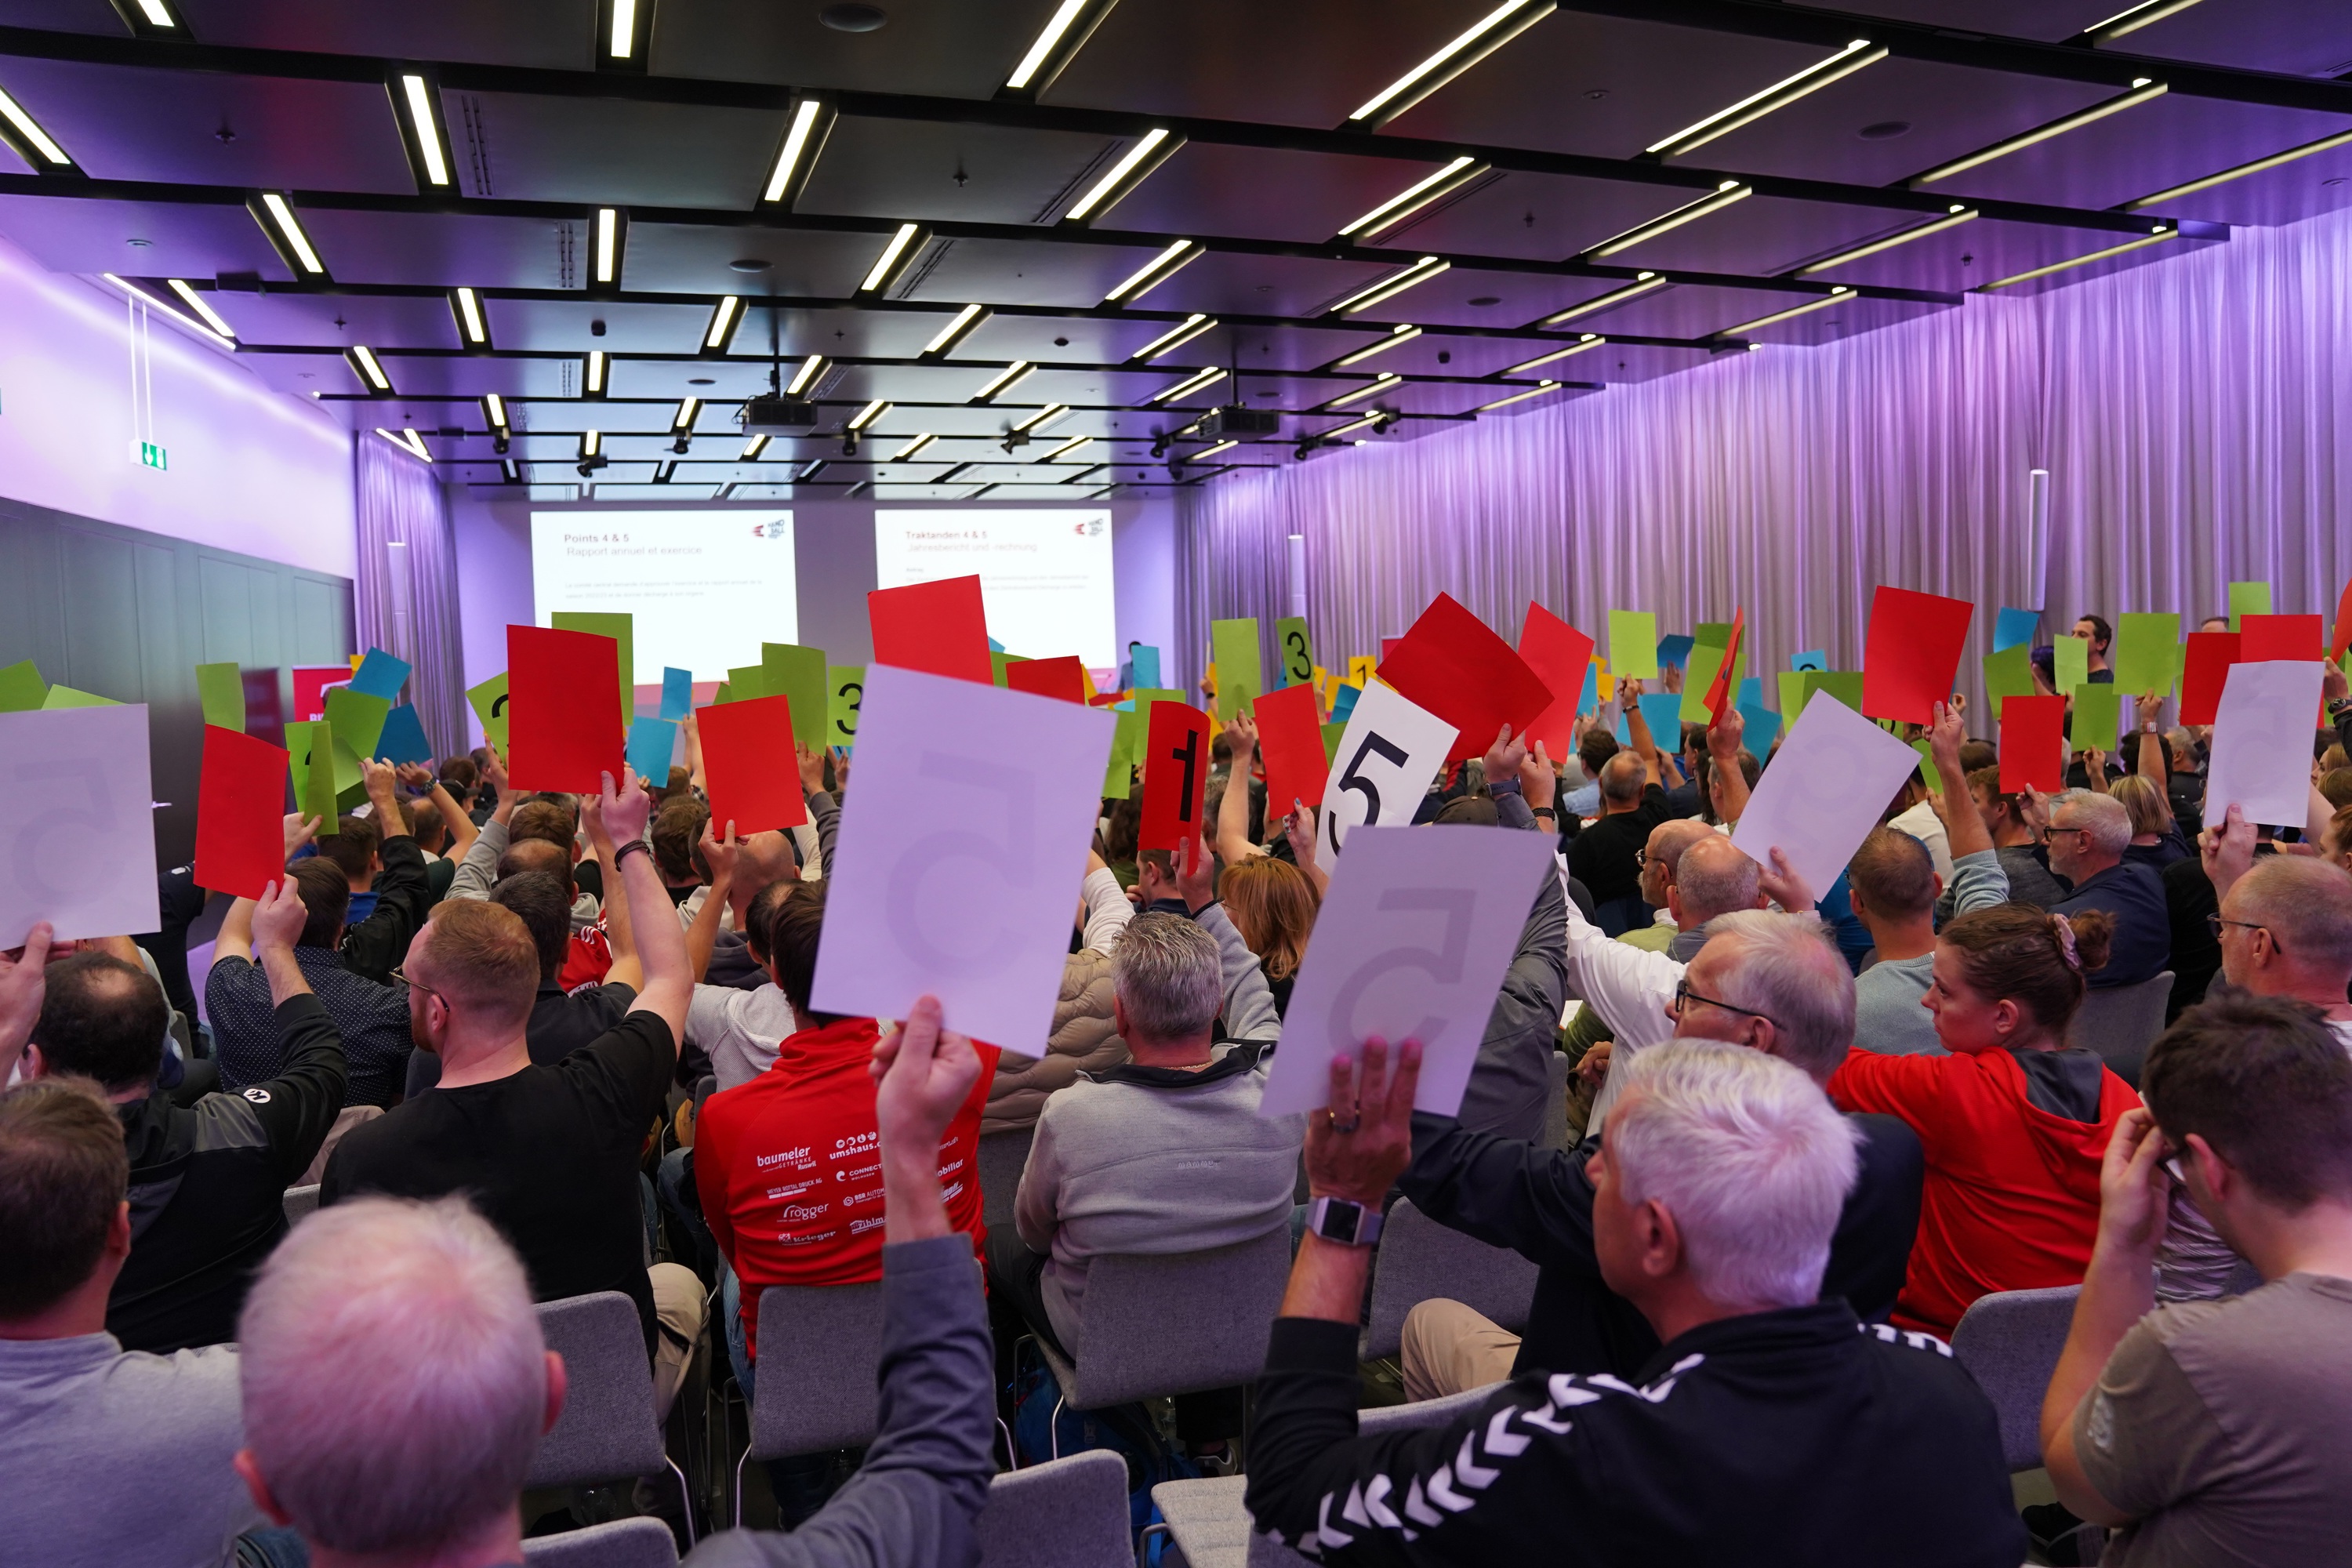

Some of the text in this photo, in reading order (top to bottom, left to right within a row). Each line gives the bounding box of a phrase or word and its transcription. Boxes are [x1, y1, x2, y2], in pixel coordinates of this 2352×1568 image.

[564, 534, 598, 543] Points
[623, 534, 630, 543] 5
[906, 531, 960, 539] Traktanden
[982, 531, 988, 539] 5
[566, 546, 702, 557] Rapport annuel et exercice
[1287, 631, 1312, 680] 3
[1356, 664, 1367, 688] 1
[837, 683, 863, 735] 3
[1329, 730, 1410, 858] 5
[757, 1146, 811, 1167] baumeler
[829, 1141, 882, 1160] umshaus.c
[779, 1156, 811, 1169] GETRÄNKE
[797, 1160, 817, 1171] Ruswil
[937, 1159, 964, 1177] obiliar
[798, 1179, 815, 1188] DRUCK
[855, 1192, 866, 1201] BSR
[866, 1188, 885, 1197] AUTOM
[793, 1231, 836, 1242] Krieger
